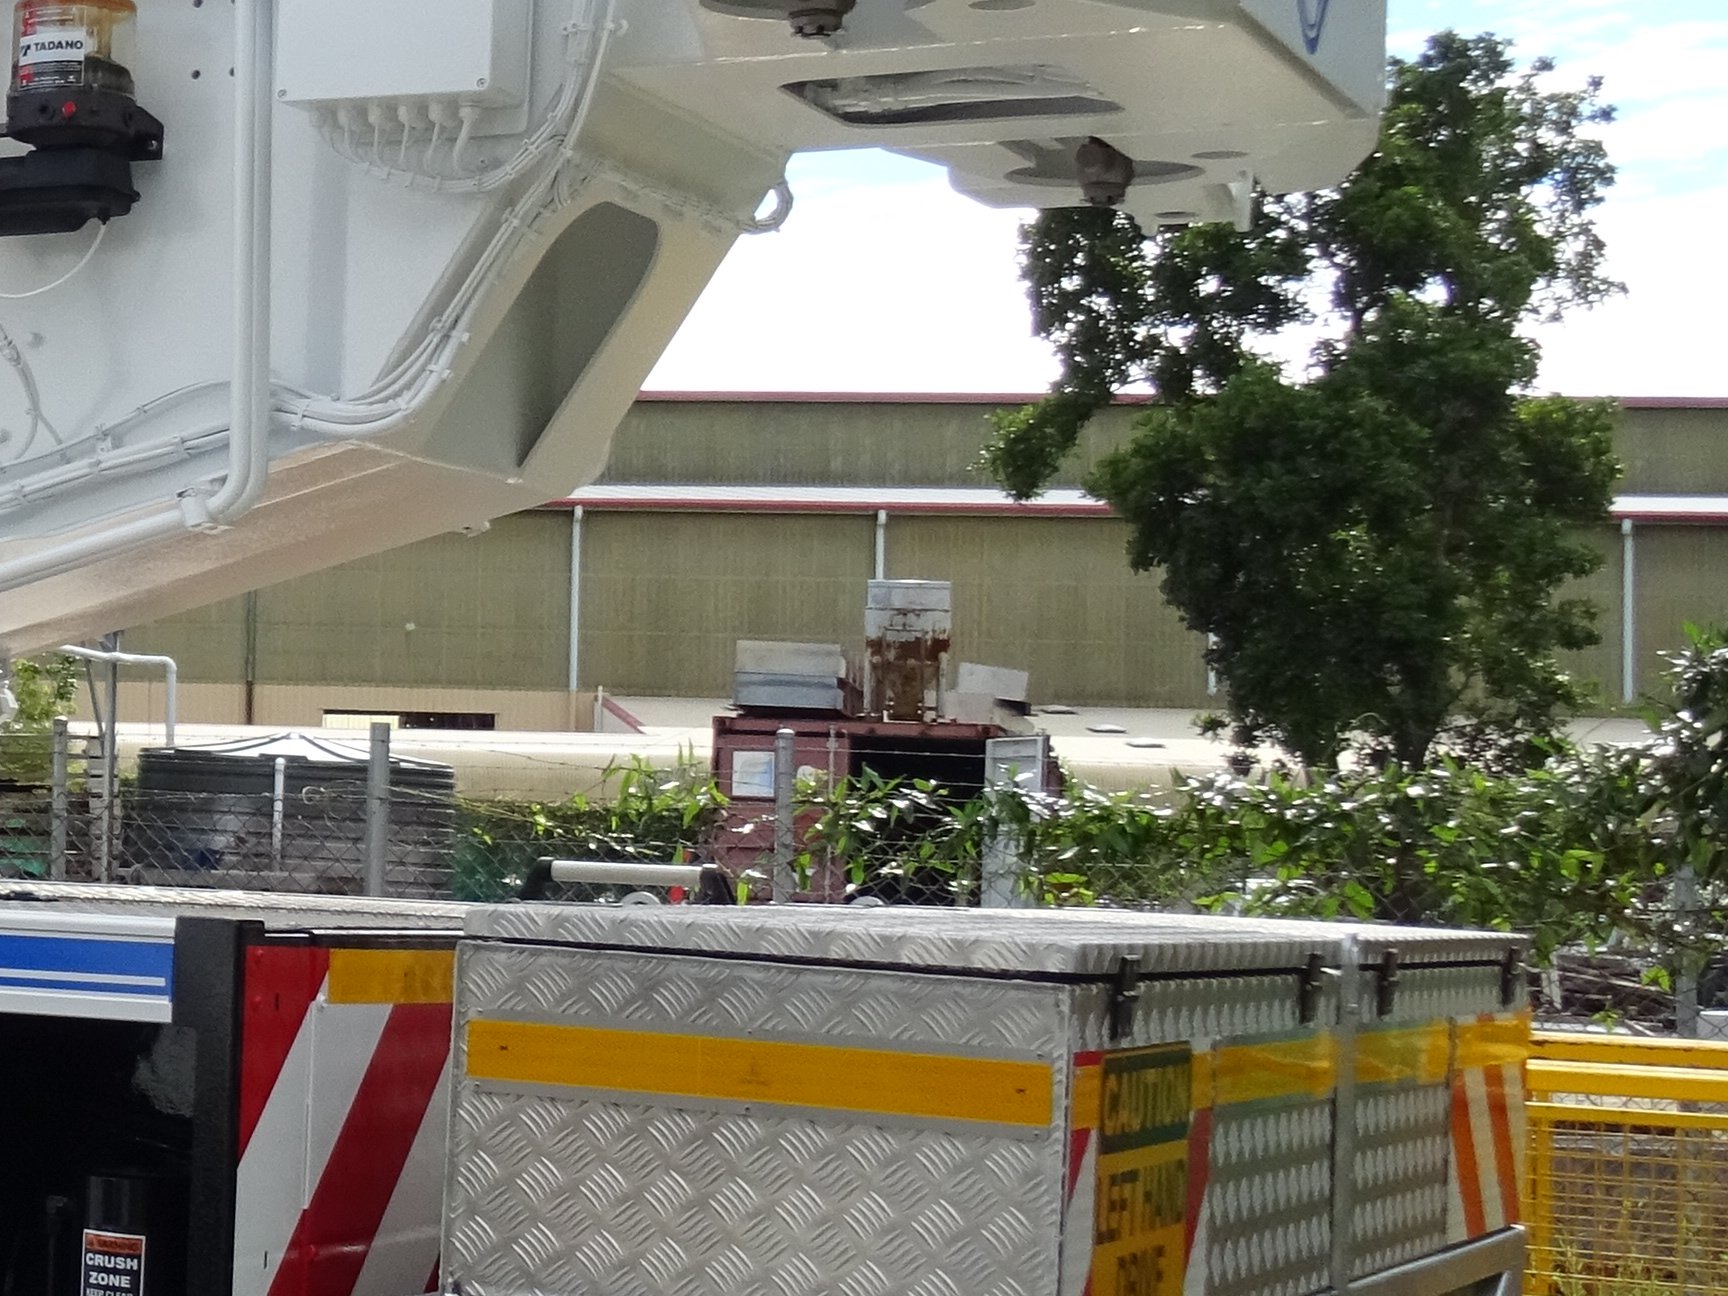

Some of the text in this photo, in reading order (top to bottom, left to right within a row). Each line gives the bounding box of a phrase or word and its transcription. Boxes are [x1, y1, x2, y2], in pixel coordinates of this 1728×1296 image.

[33, 39, 84, 53] TADANO
[85, 1253, 138, 1270] CRUSH
[88, 1271, 131, 1287] ZONE
